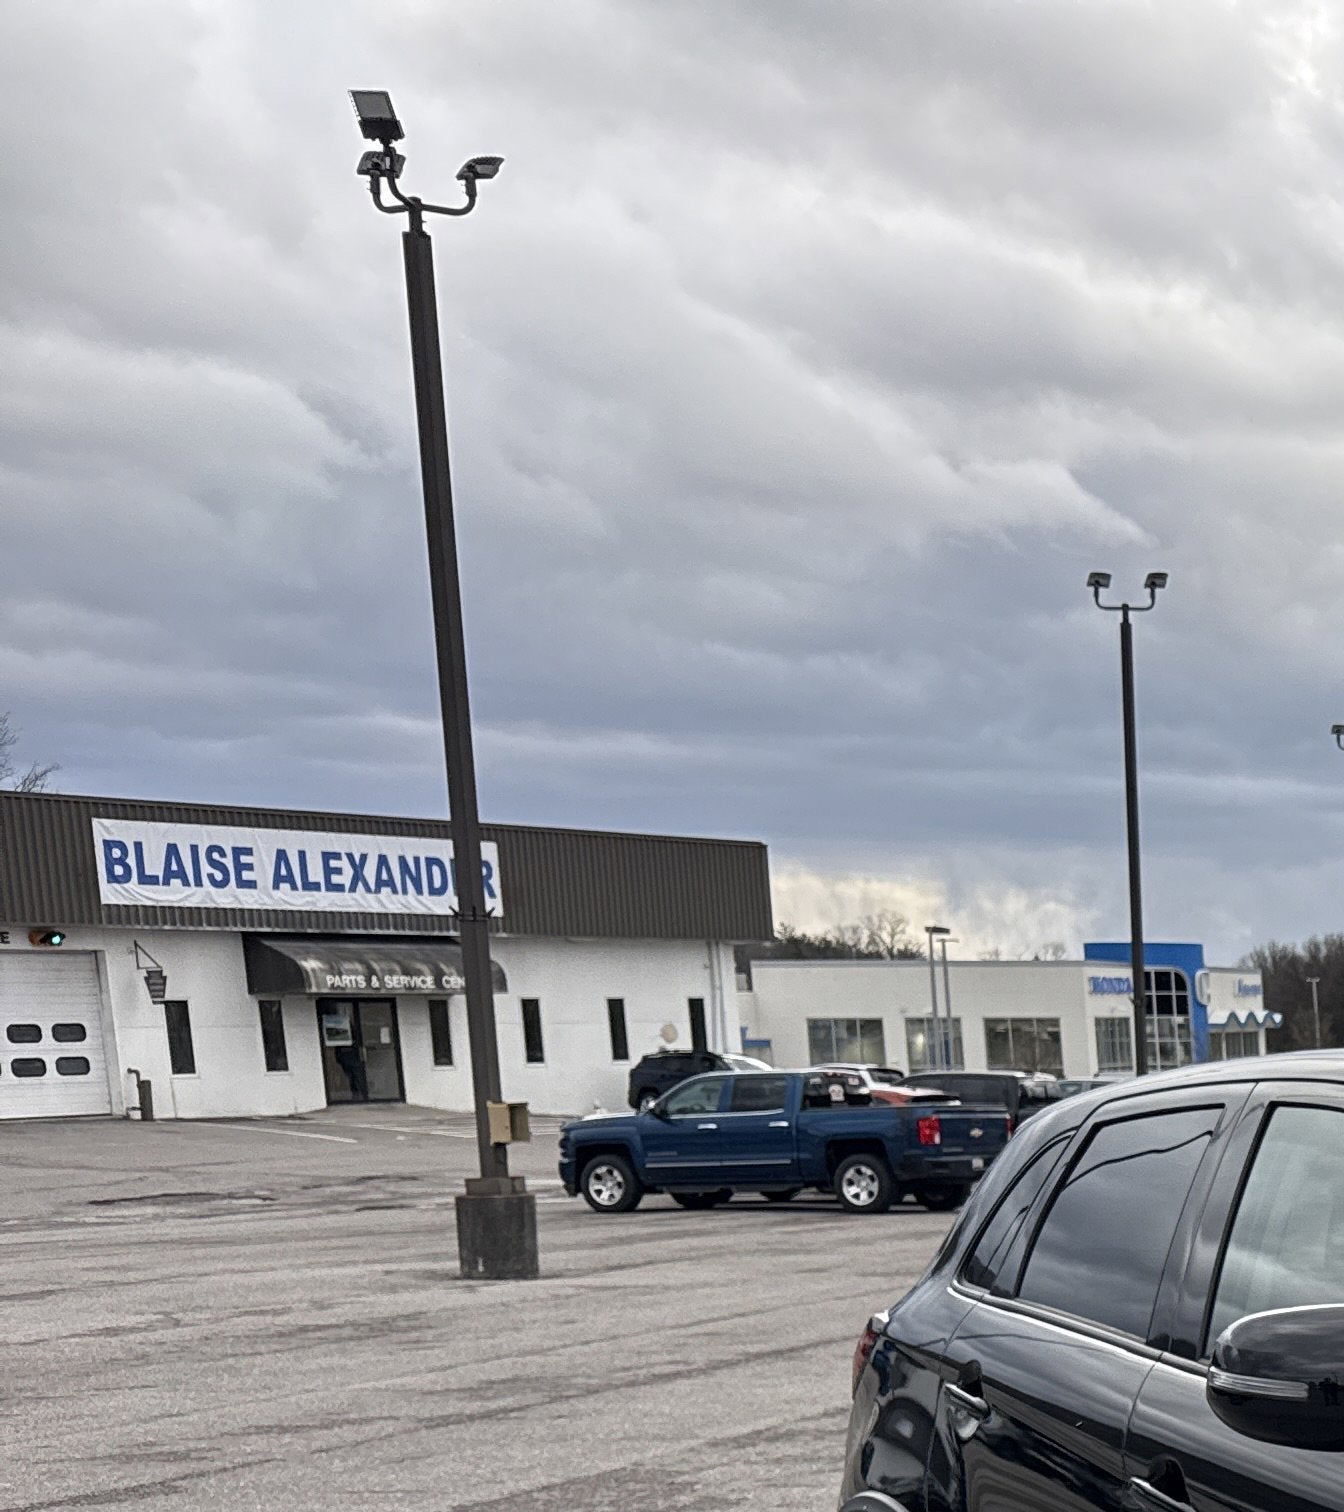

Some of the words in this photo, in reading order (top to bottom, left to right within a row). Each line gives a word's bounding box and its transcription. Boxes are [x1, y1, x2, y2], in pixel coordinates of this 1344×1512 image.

[102, 838, 258, 889] BLAISE
[272, 848, 497, 899] ALEXANDR
[325, 975, 366, 989] PARTS
[371, 975, 380, 989] &
[384, 975, 436, 989] SERVICE
